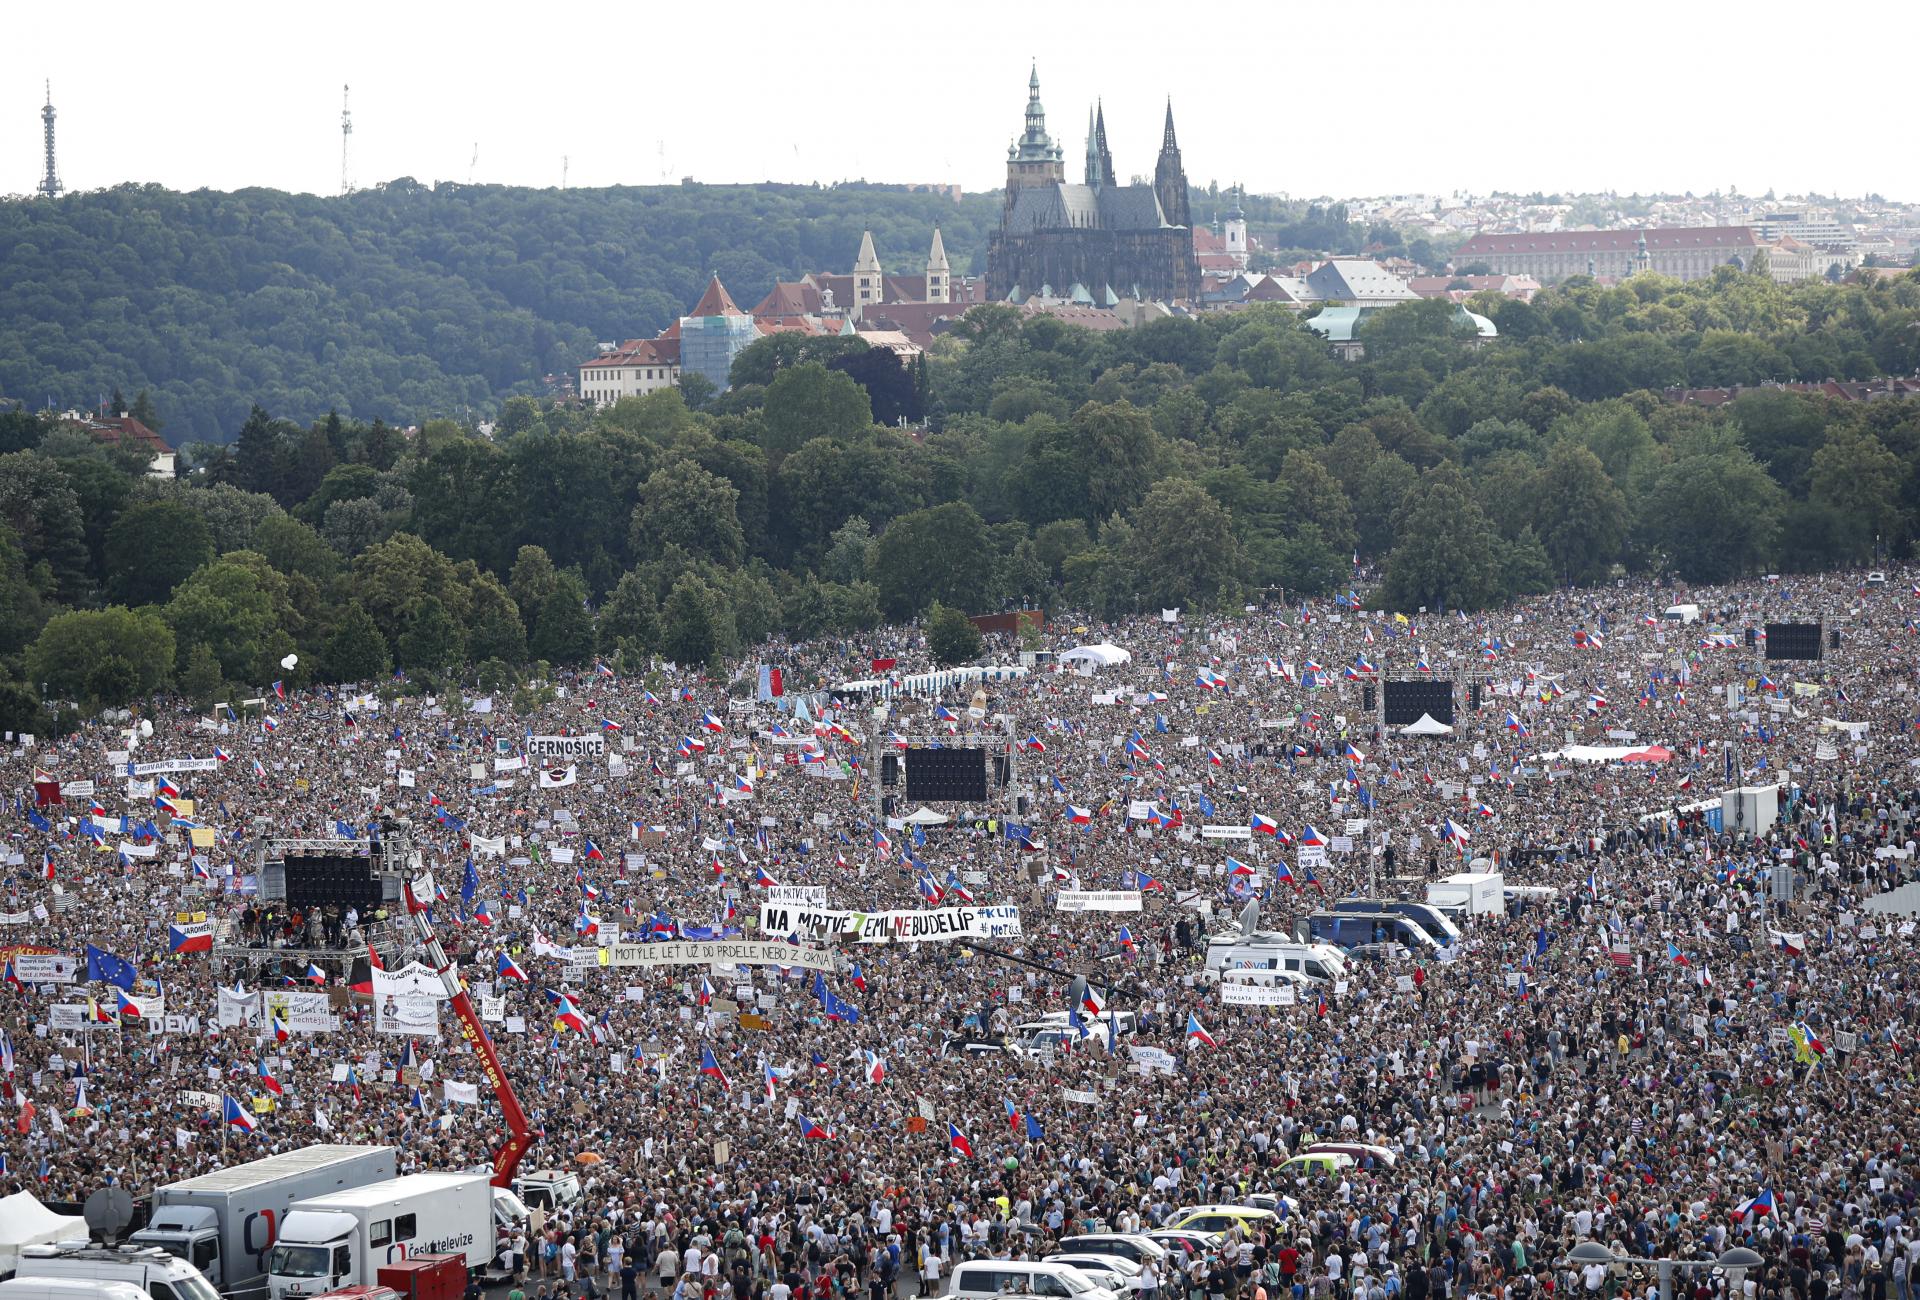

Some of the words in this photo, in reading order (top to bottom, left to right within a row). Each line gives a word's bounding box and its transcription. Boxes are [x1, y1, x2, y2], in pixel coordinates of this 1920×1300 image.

[528, 737, 603, 755] ČERNOŠICE
[770, 887, 781, 899] NA
[783, 886, 803, 899] MRTVÉ
[766, 908, 788, 932] NA
[797, 911, 851, 937] MRTVÉ
[615, 946, 659, 961] MOTÝLE,
[685, 943, 699, 958] UŽ
[703, 945, 715, 958] DO
[717, 945, 759, 960] PRDELE,
[762, 946, 787, 961] NEBO
[790, 949, 799, 961] Z
[803, 951, 831, 967] OKNA
[1235, 960, 1268, 969] nova
[464, 1023, 480, 1044] 257
[486, 1067, 502, 1089] 666
[437, 1233, 473, 1252] televize
